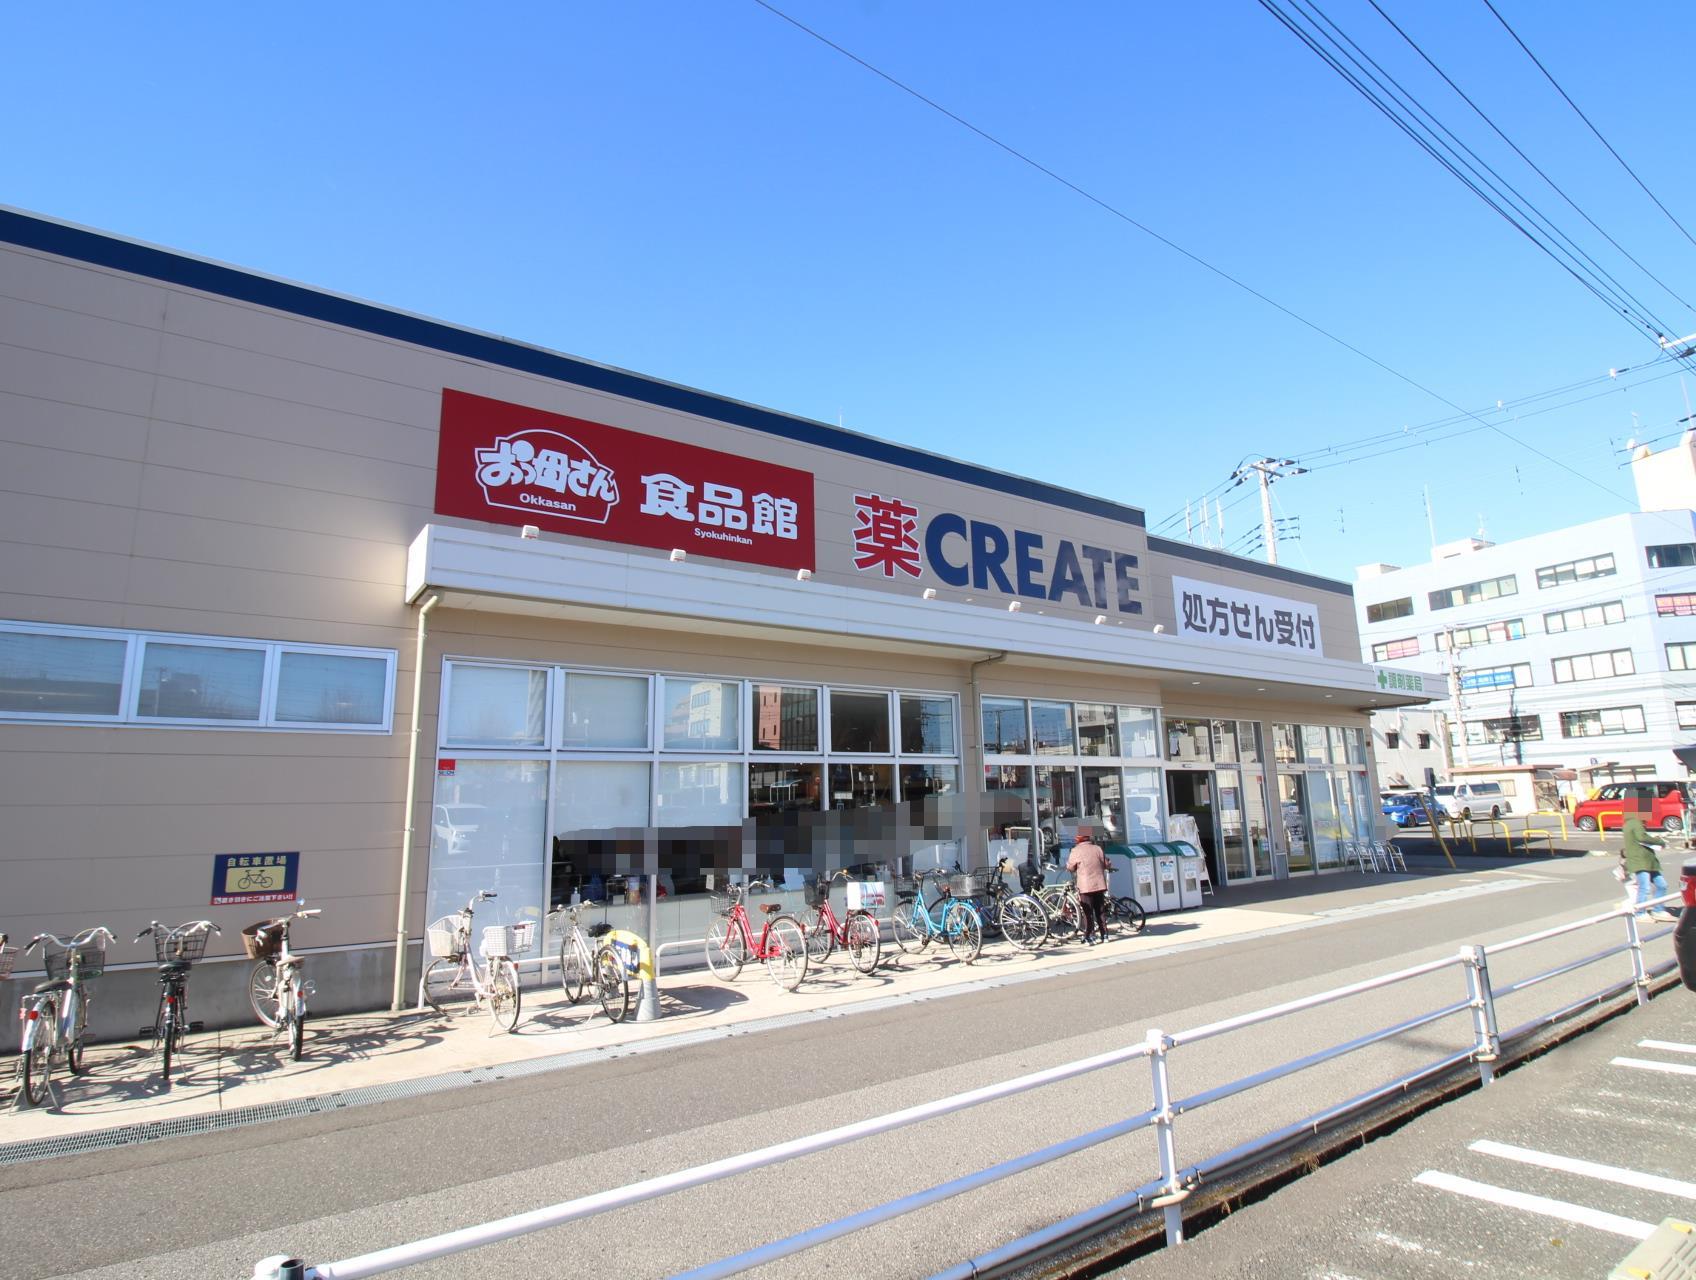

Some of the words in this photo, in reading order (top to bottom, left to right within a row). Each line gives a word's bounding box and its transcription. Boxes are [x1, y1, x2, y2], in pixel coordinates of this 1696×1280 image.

[520, 493, 577, 511] Okkasan
[640, 473, 798, 540] 食品館
[694, 527, 753, 545] Syokuhinkan
[853, 494, 923, 578] 薬
[924, 512, 1143, 615] CREATE
[1182, 591, 1316, 650] 処方せん受付
